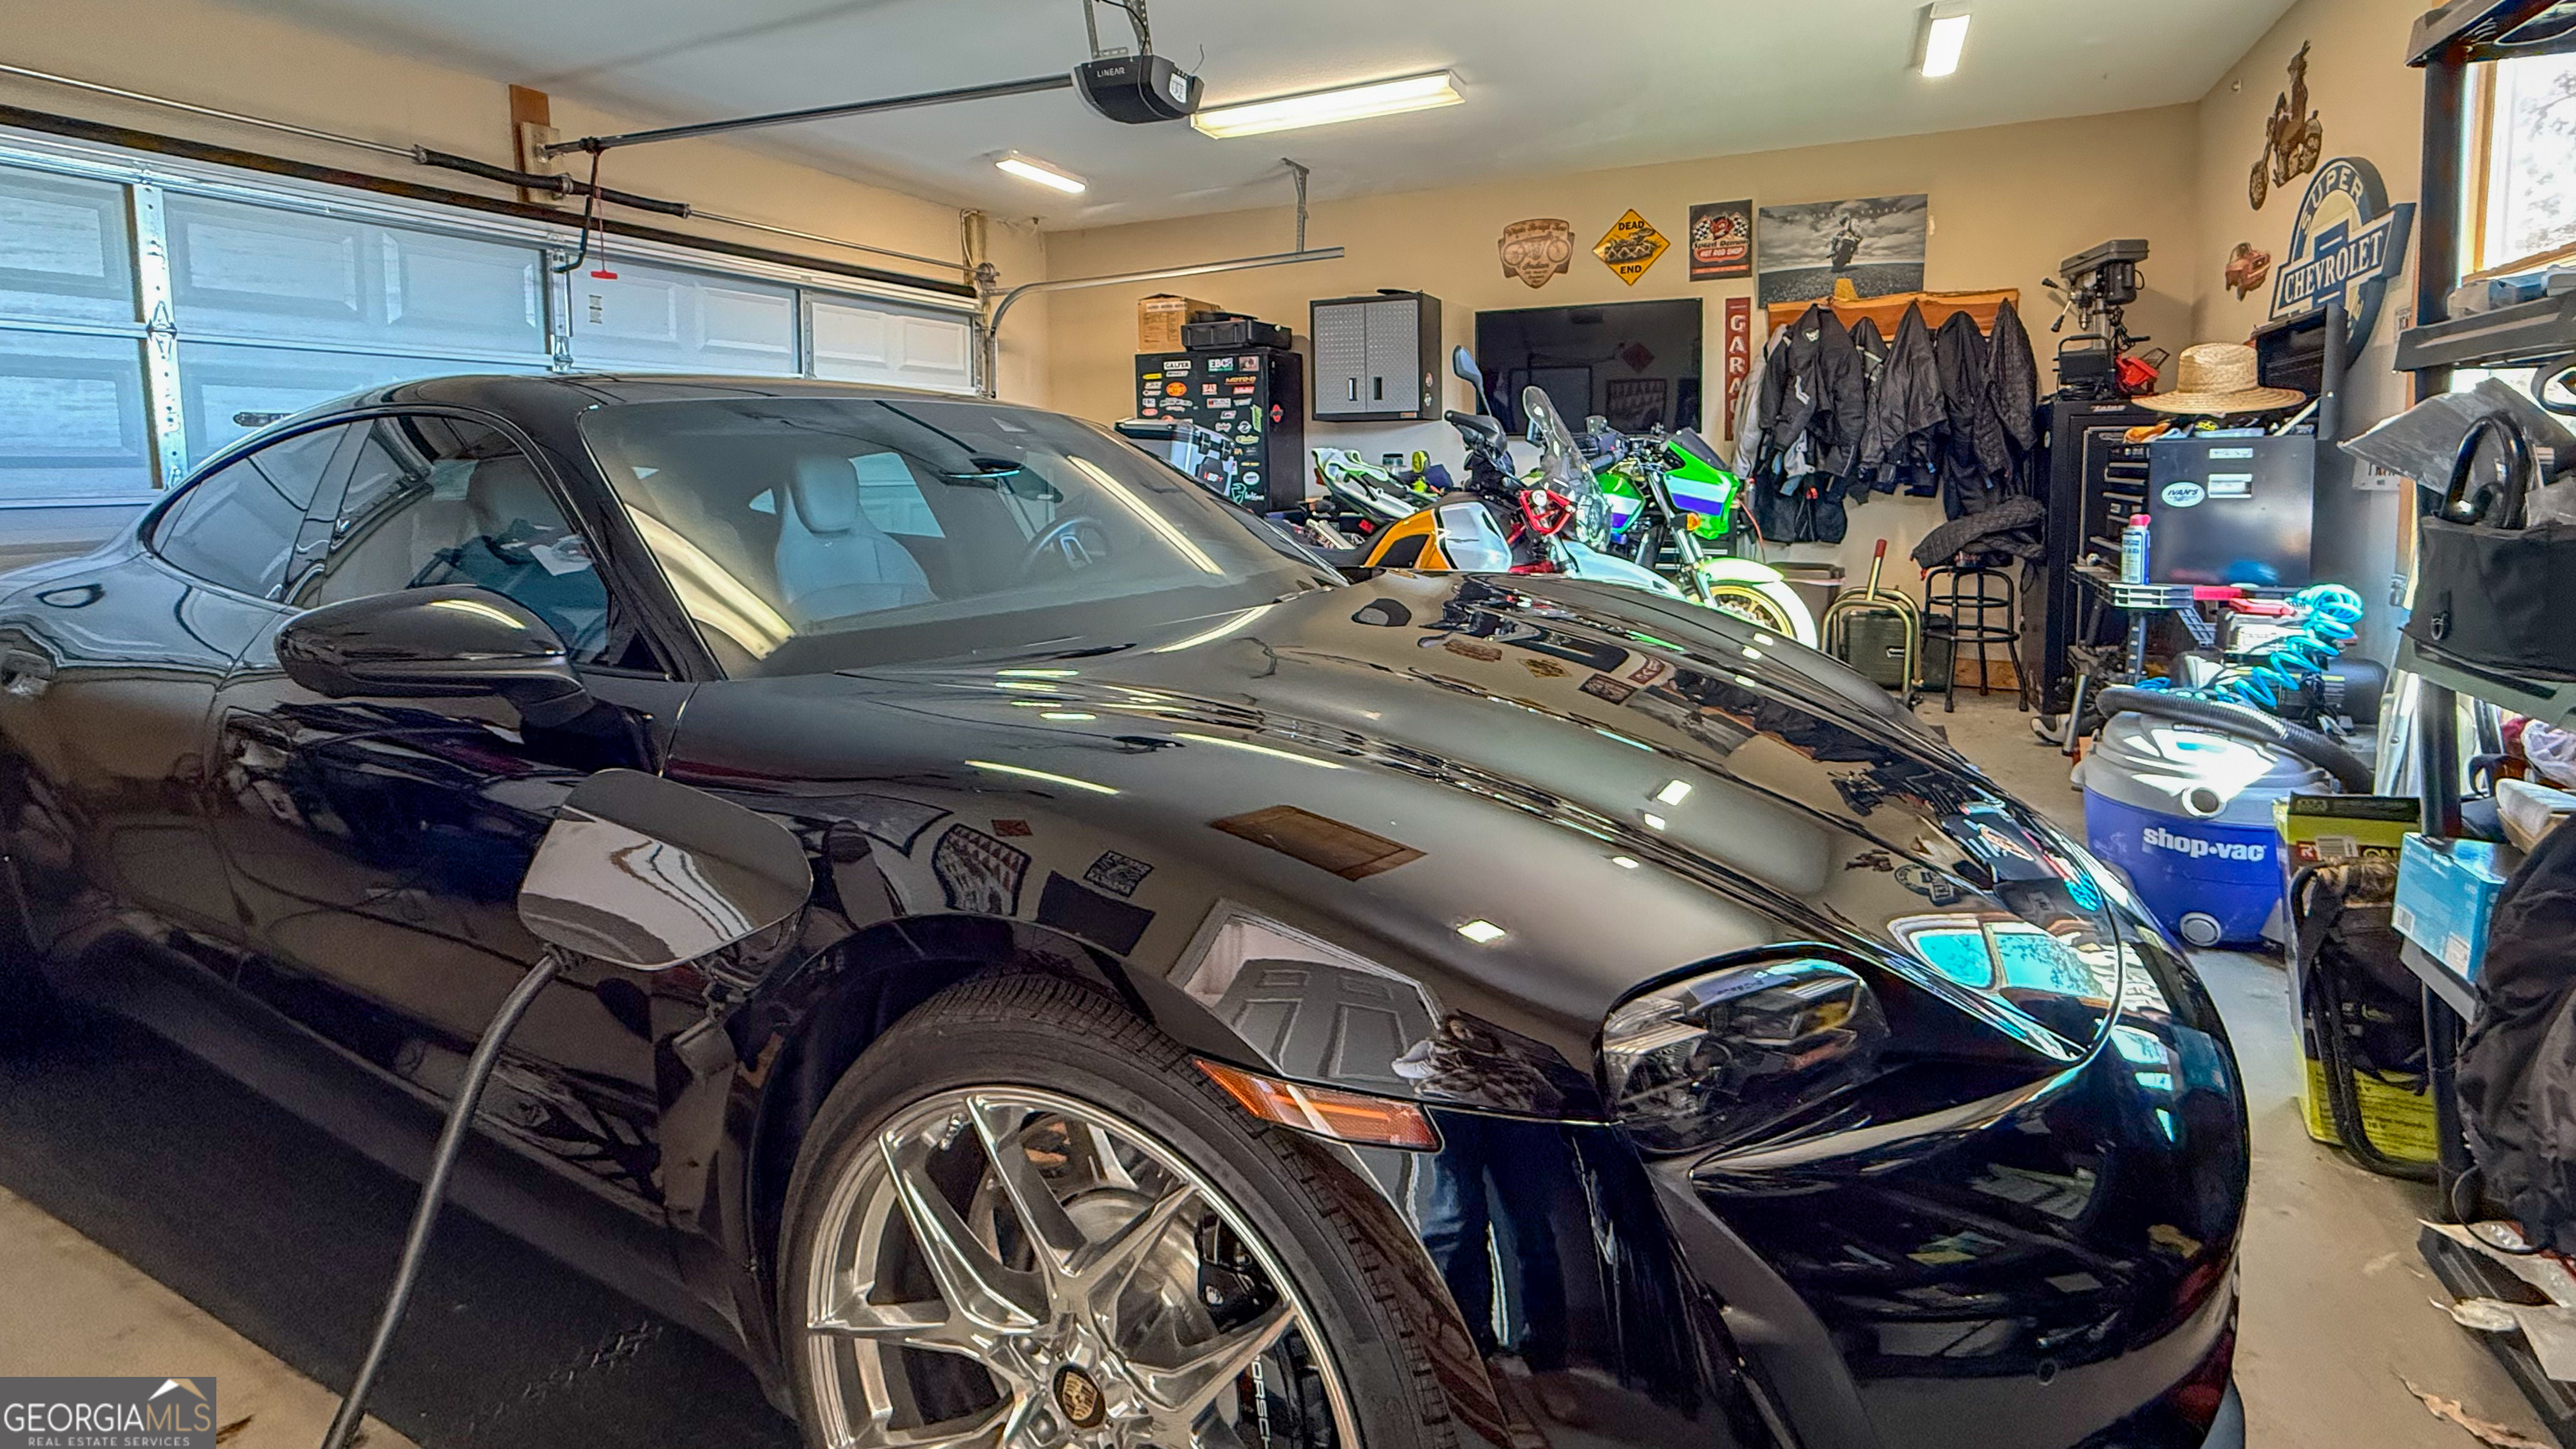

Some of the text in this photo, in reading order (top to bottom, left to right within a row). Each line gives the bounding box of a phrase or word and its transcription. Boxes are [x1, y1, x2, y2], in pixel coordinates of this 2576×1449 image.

[1096, 66, 1125, 78] LINEAR
[1618, 221, 1644, 231] DEAD
[2301, 166, 2365, 236] SUPER
[1620, 264, 1643, 274] END
[2283, 230, 2383, 304] CHEVROLET
[1728, 314, 1747, 413] GARA
[1251, 1354, 1271, 1449] ORSCH
